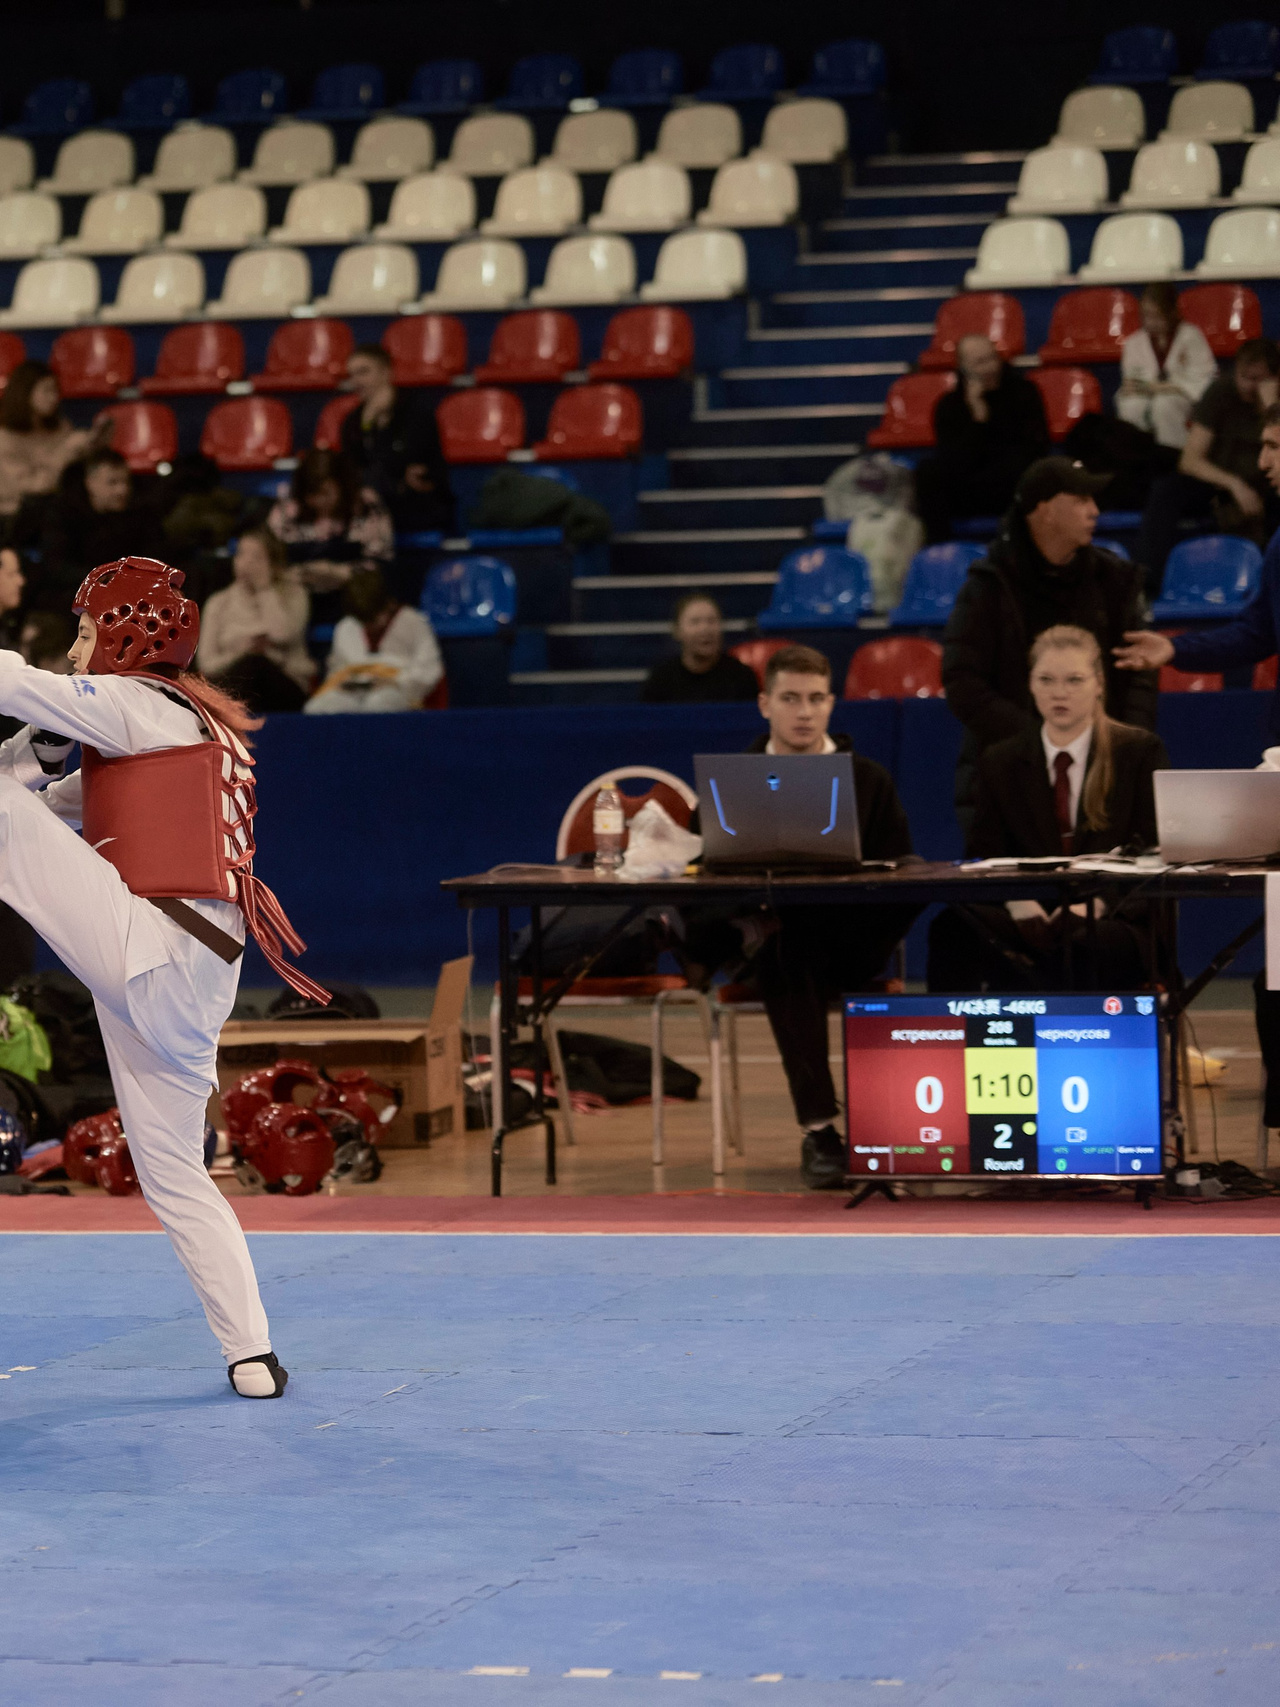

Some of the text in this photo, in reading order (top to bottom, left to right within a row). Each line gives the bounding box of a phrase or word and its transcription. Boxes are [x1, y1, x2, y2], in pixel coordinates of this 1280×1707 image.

[1002, 1000, 1046, 1014] -46KG
[1036, 1029, 1111, 1042] черноусова
[972, 1074, 1033, 1097] 1:10
[915, 1076, 943, 1113] 0
[1061, 1076, 1089, 1113] 0
[993, 1123, 1013, 1149] 2
[868, 1158, 879, 1171] 0
[941, 1158, 953, 1171] 0
[984, 1158, 1025, 1171] Round
[1056, 1158, 1067, 1171] 0
[1131, 1158, 1142, 1171] 0
